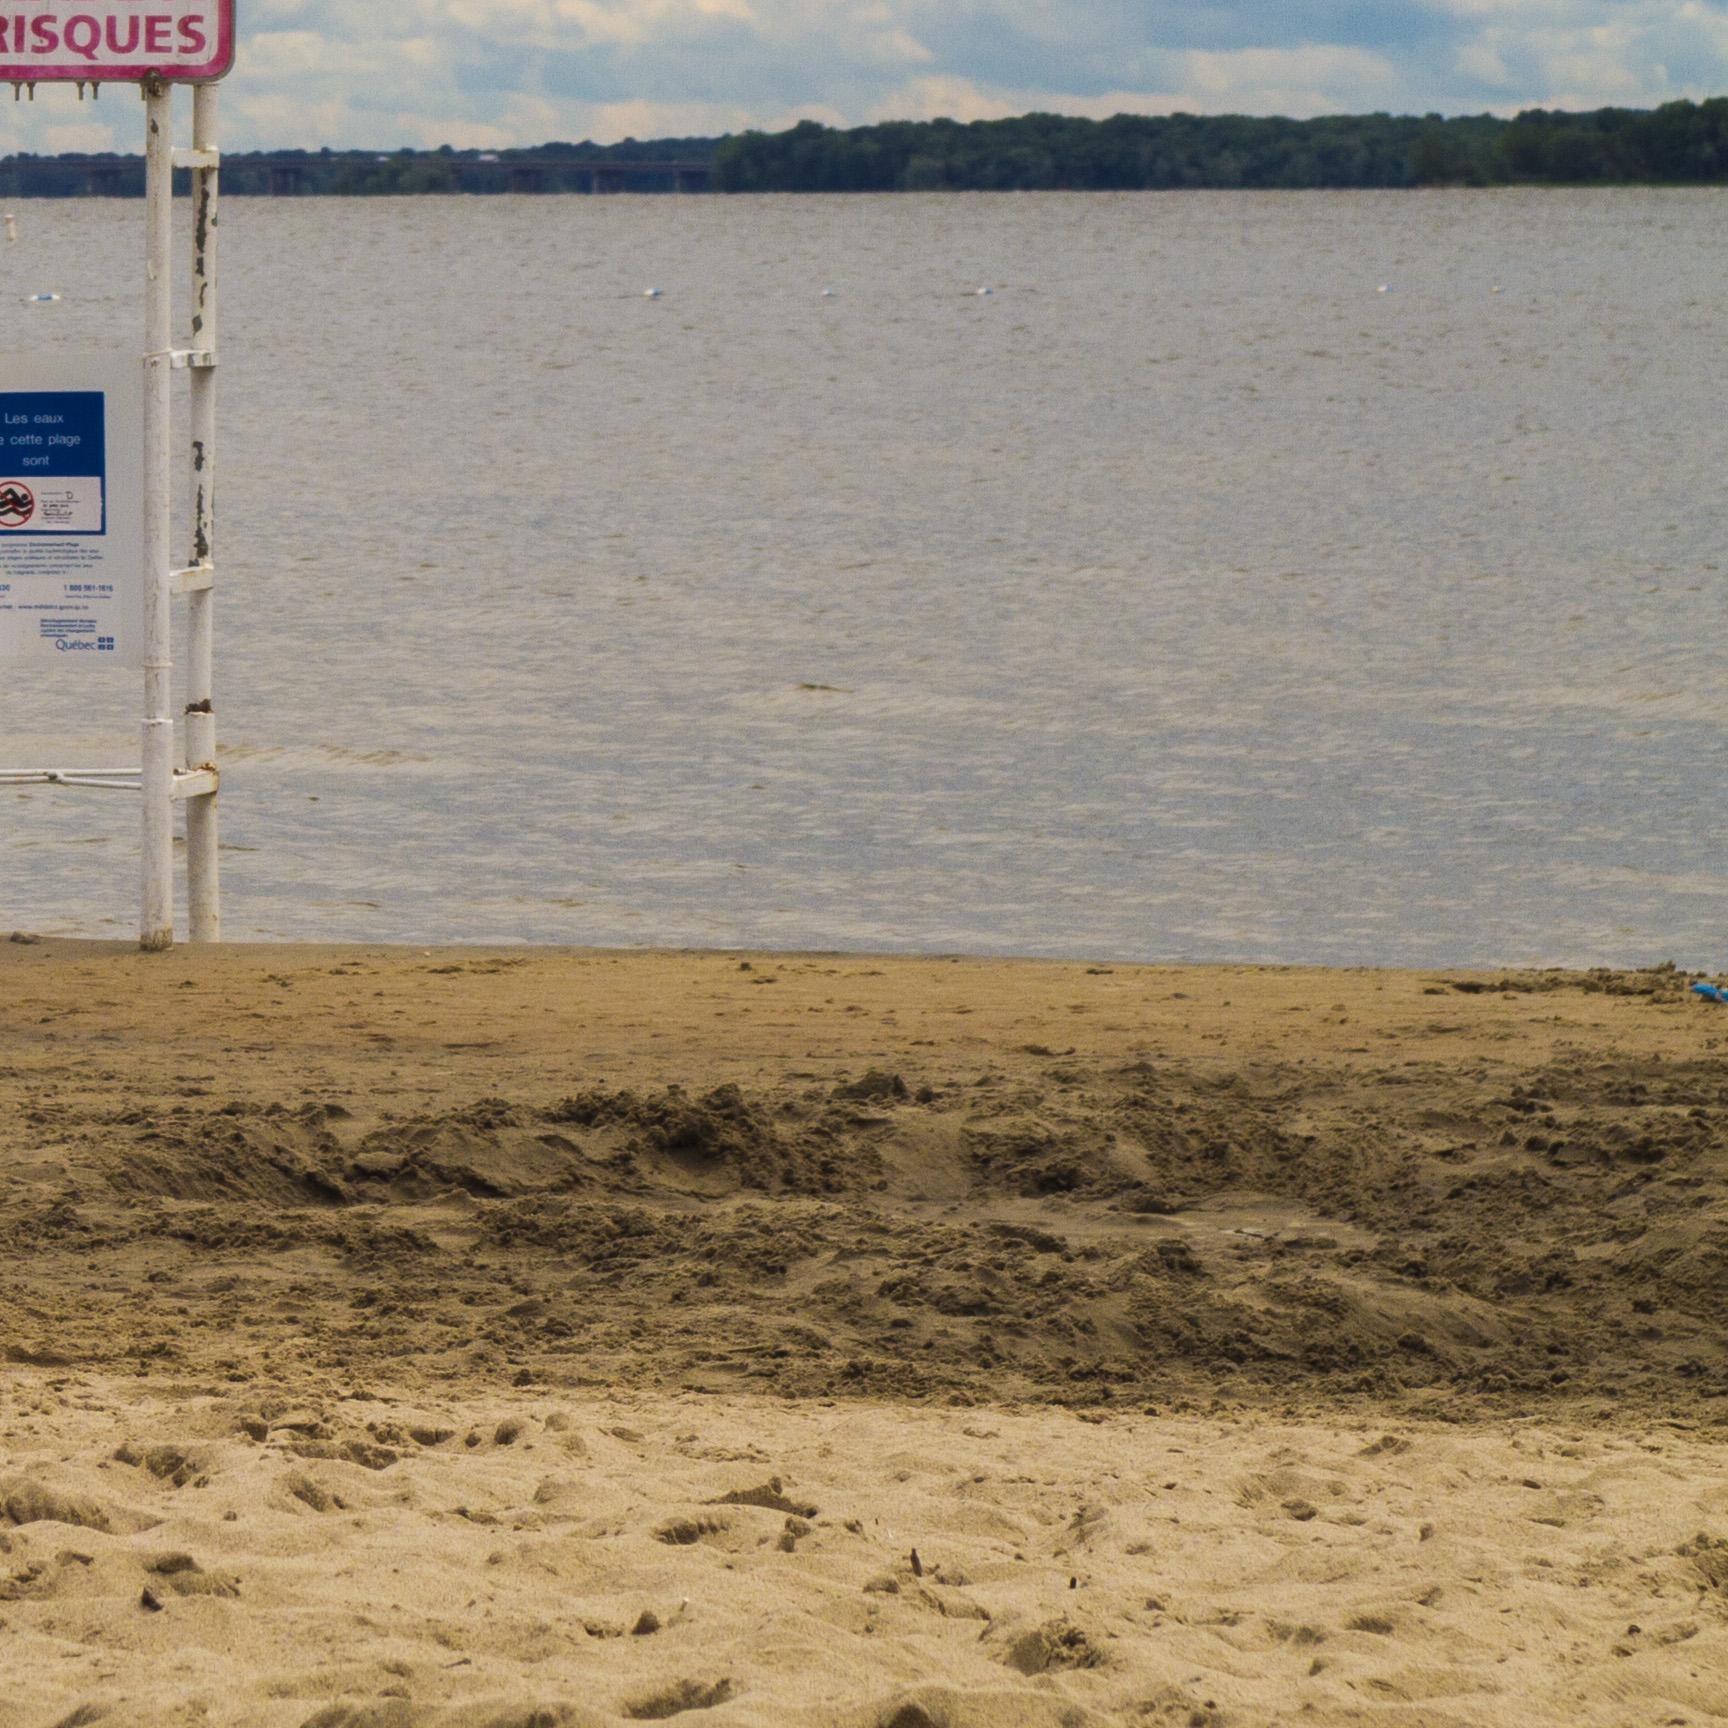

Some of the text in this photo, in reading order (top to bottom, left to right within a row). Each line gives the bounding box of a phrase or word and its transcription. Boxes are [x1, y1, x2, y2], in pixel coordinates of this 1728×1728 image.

[4, 413, 64, 424] Les eaux
[10, 434, 43, 446] cette
[48, 434, 81, 448] plage
[22, 455, 50, 466] sont
[55, 638, 96, 652] Québec
